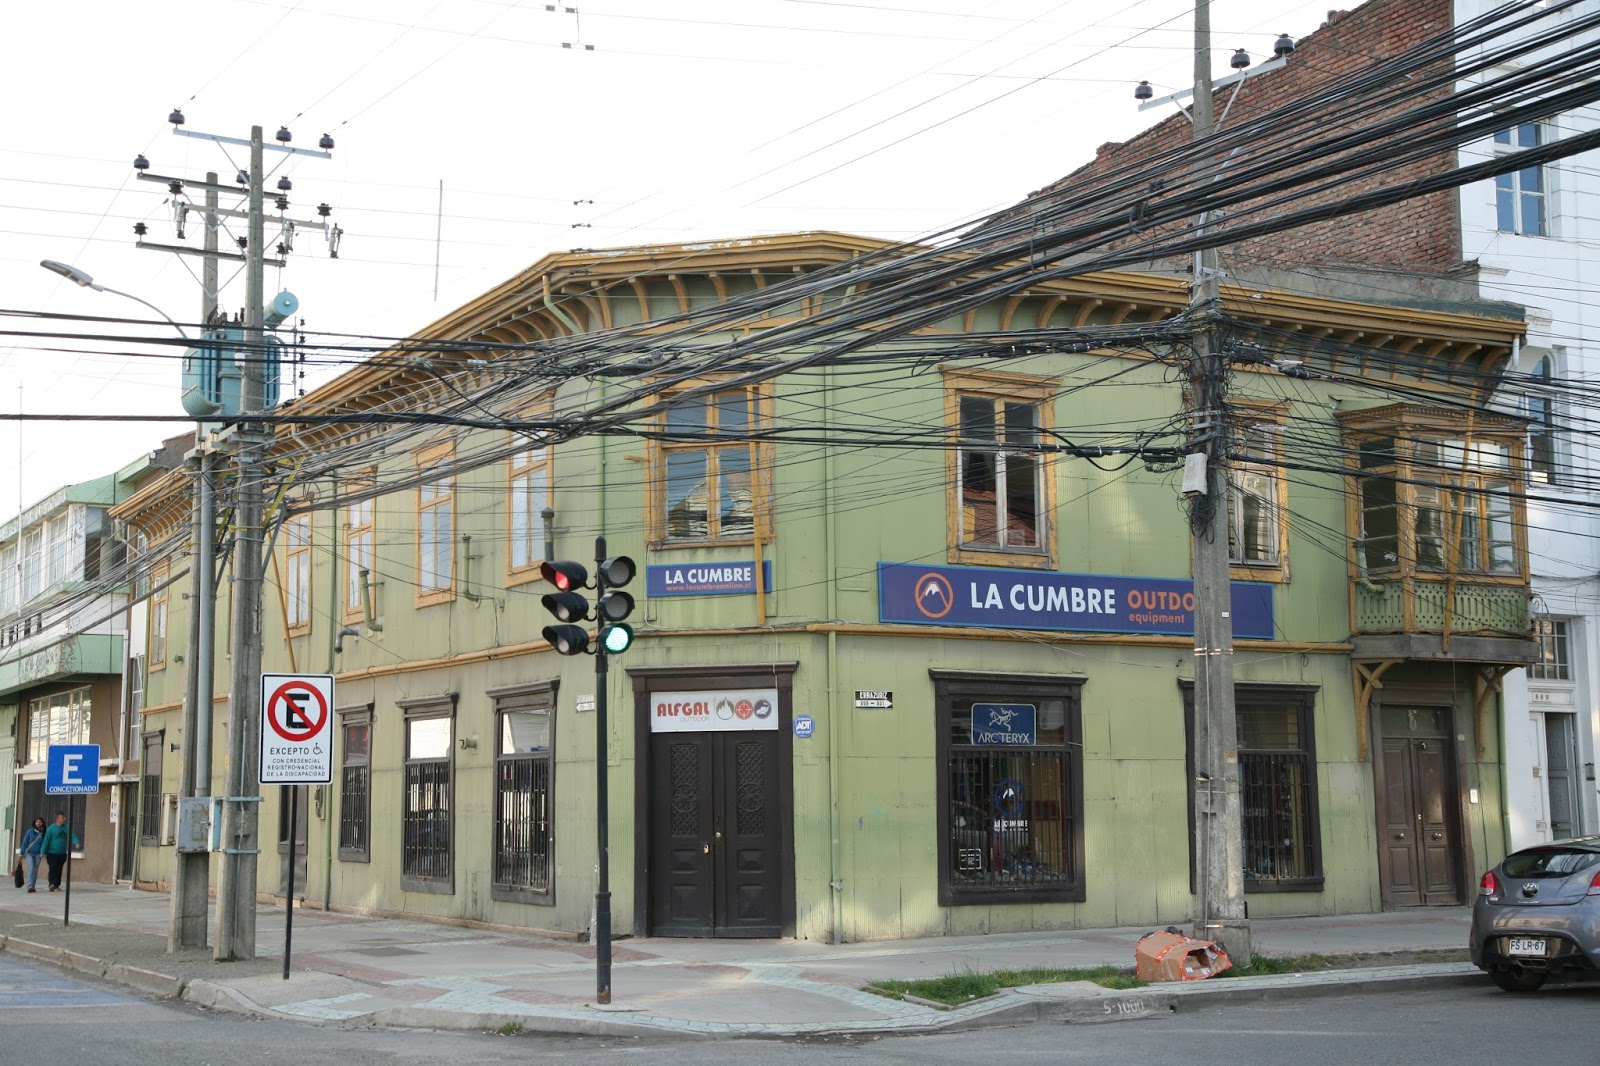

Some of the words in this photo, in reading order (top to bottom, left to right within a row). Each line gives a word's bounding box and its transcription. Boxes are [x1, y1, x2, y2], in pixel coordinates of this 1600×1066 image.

[665, 570, 684, 584] LA
[687, 567, 751, 584] CUMBRE
[970, 582, 1003, 609] LA
[1009, 584, 1116, 614] CUMBRE
[1127, 589, 1195, 611] OUTDO
[1128, 612, 1185, 625] equipment
[1535, 693, 1550, 701] 889
[657, 702, 710, 717] ALFGAL
[796, 720, 811, 730] ADT
[270, 747, 310, 755] EXCEPTO
[62, 754, 83, 784] E
